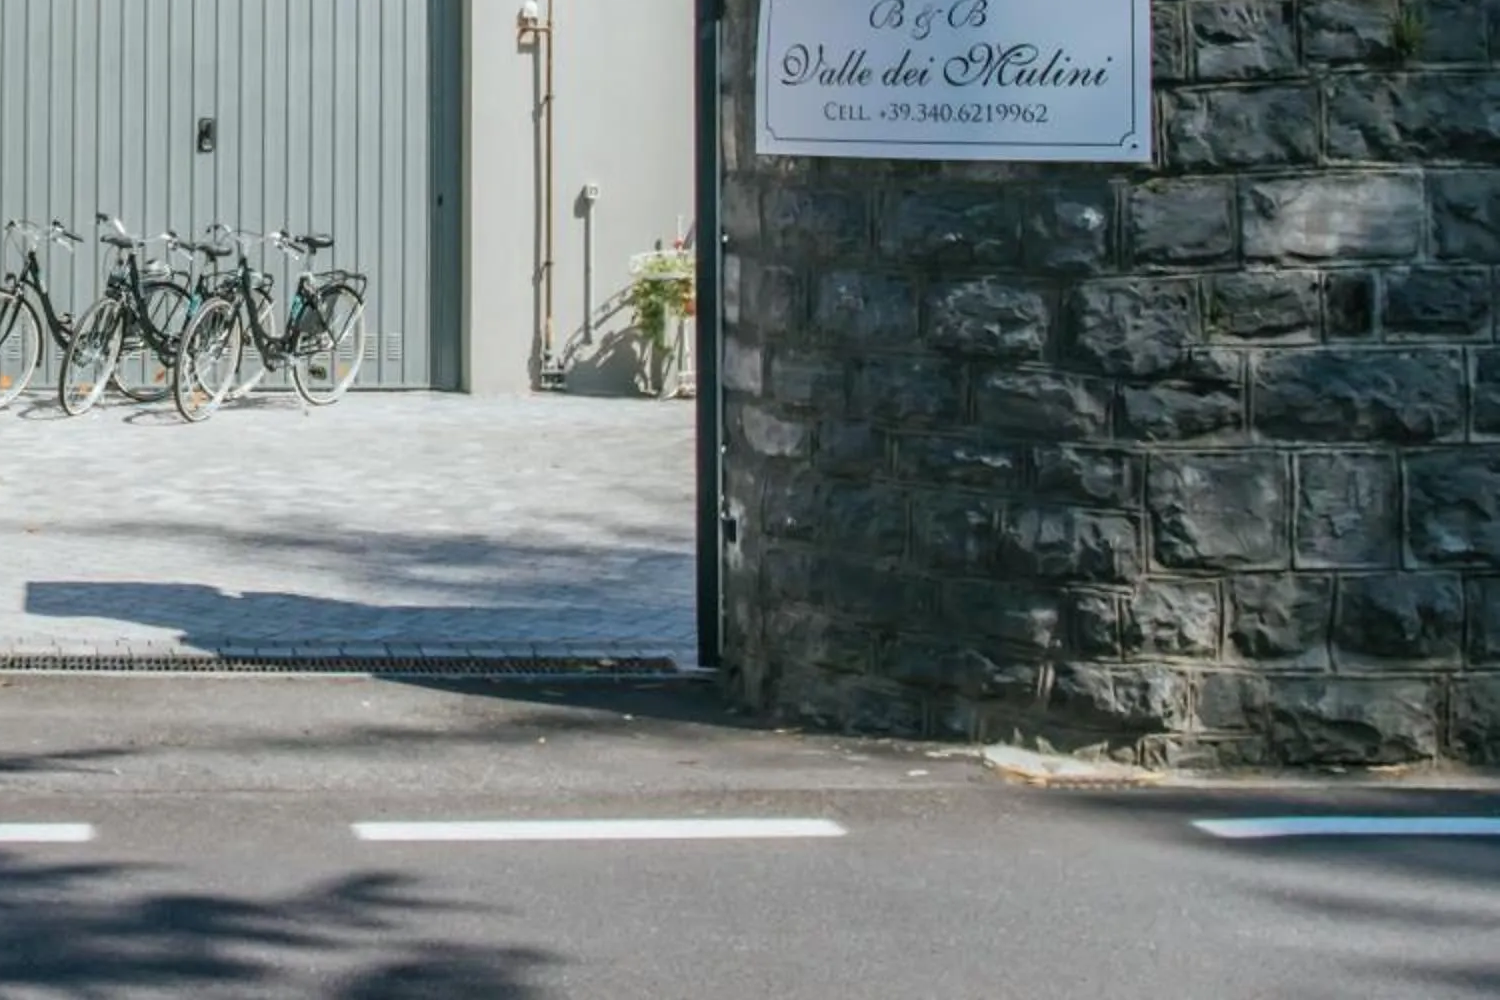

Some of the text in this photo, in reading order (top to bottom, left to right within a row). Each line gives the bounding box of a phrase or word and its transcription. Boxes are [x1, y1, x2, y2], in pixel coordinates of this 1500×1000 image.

[913, 3, 943, 40] &
[781, 42, 1113, 88] Valle dei Mulini
[880, 104, 1049, 123] +39.340.6219962
